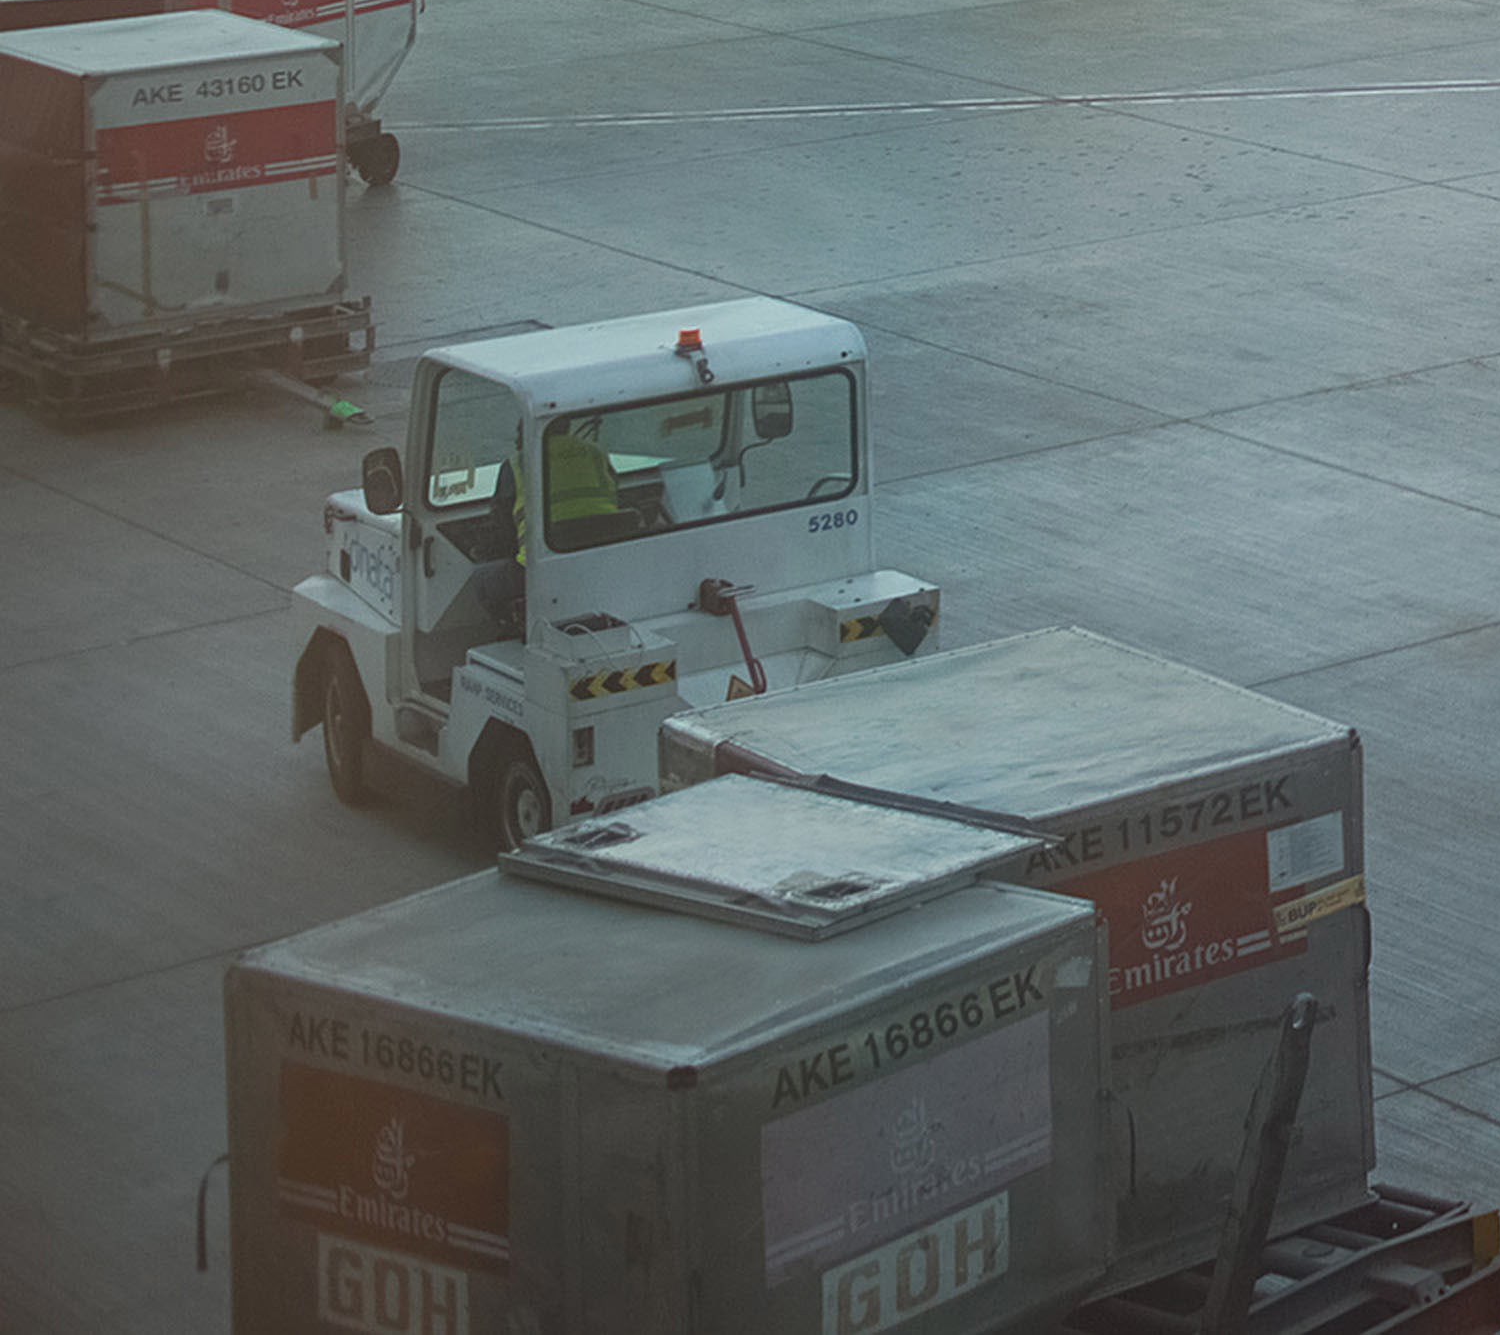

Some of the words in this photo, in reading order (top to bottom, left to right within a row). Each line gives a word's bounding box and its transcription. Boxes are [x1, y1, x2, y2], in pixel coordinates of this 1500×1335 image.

[131, 83, 184, 108] AKE
[195, 74, 266, 99] 43160
[271, 68, 304, 91] EK
[807, 508, 859, 533] 5280
[1024, 824, 1104, 876] AKE
[1118, 791, 1234, 852] 11572
[1238, 774, 1294, 815] EK
[1106, 935, 1236, 998] Emirates
[288, 1011, 350, 1061] AKE
[361, 1028, 456, 1086] 16866
[458, 1052, 506, 1100] EK
[771, 1042, 857, 1111] AKE
[863, 991, 985, 1071] 16866
[987, 963, 1045, 1020] EK
[336, 1183, 449, 1243] Emirates
[326, 1243, 457, 1335] GOH
[836, 1204, 999, 1334] GOH
